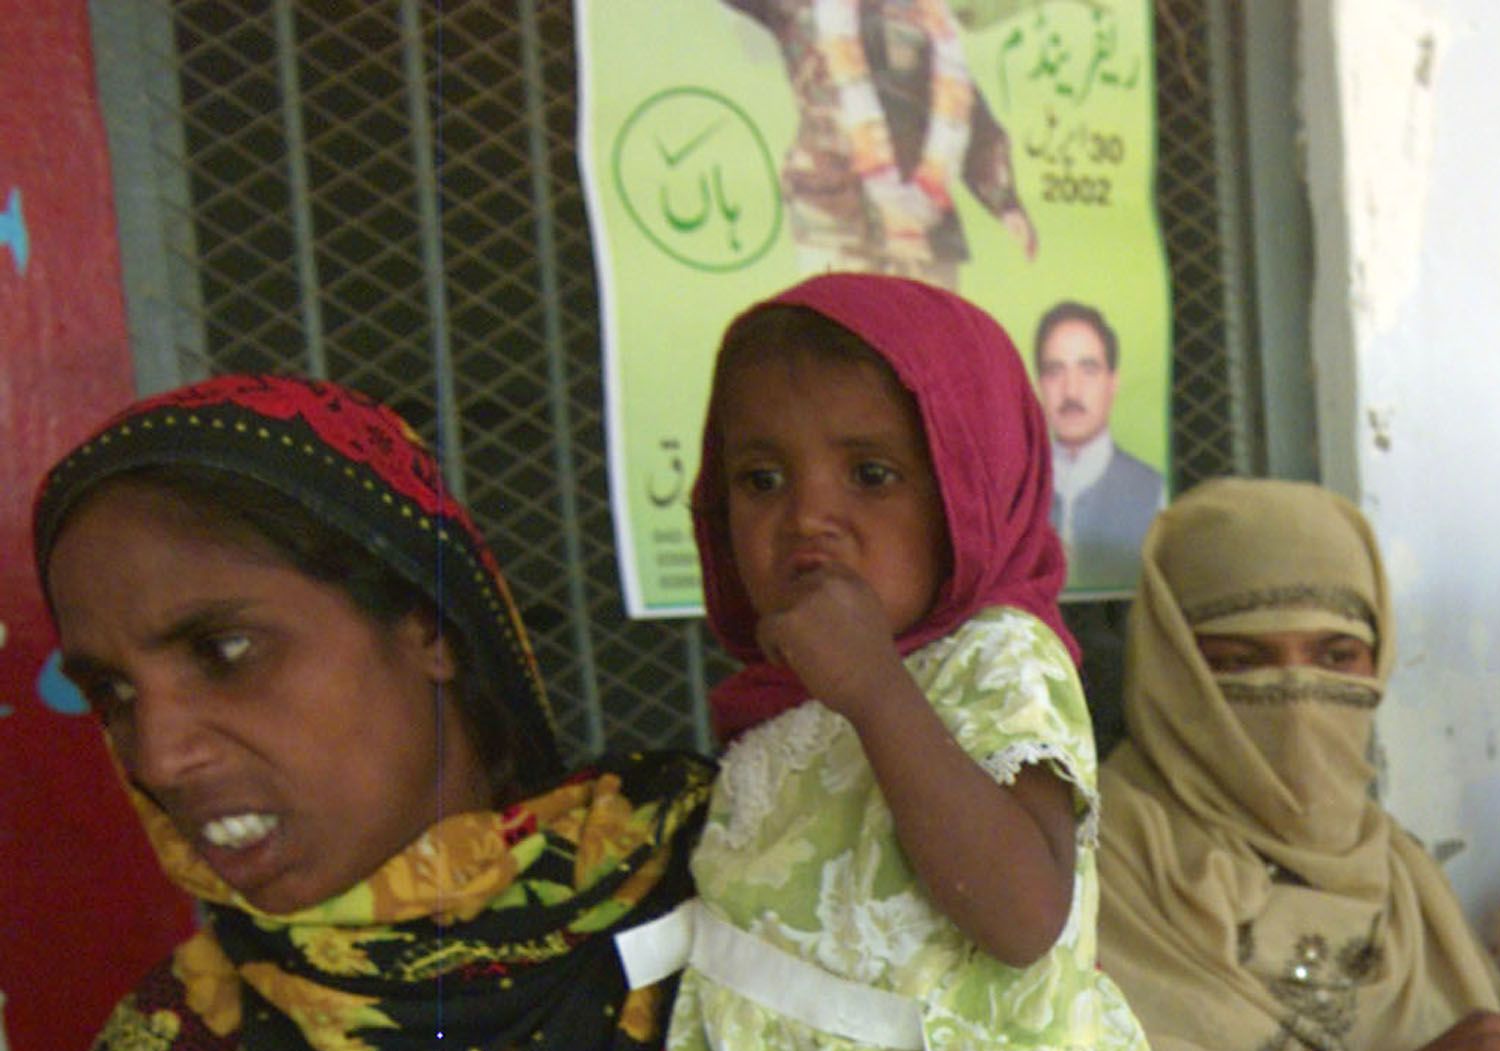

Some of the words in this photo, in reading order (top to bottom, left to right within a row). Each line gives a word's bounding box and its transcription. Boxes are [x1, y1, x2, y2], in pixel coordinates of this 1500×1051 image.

[1090, 132, 1125, 166] 30
[1042, 172, 1112, 207] 2002
[658, 162, 743, 254] ہاں
